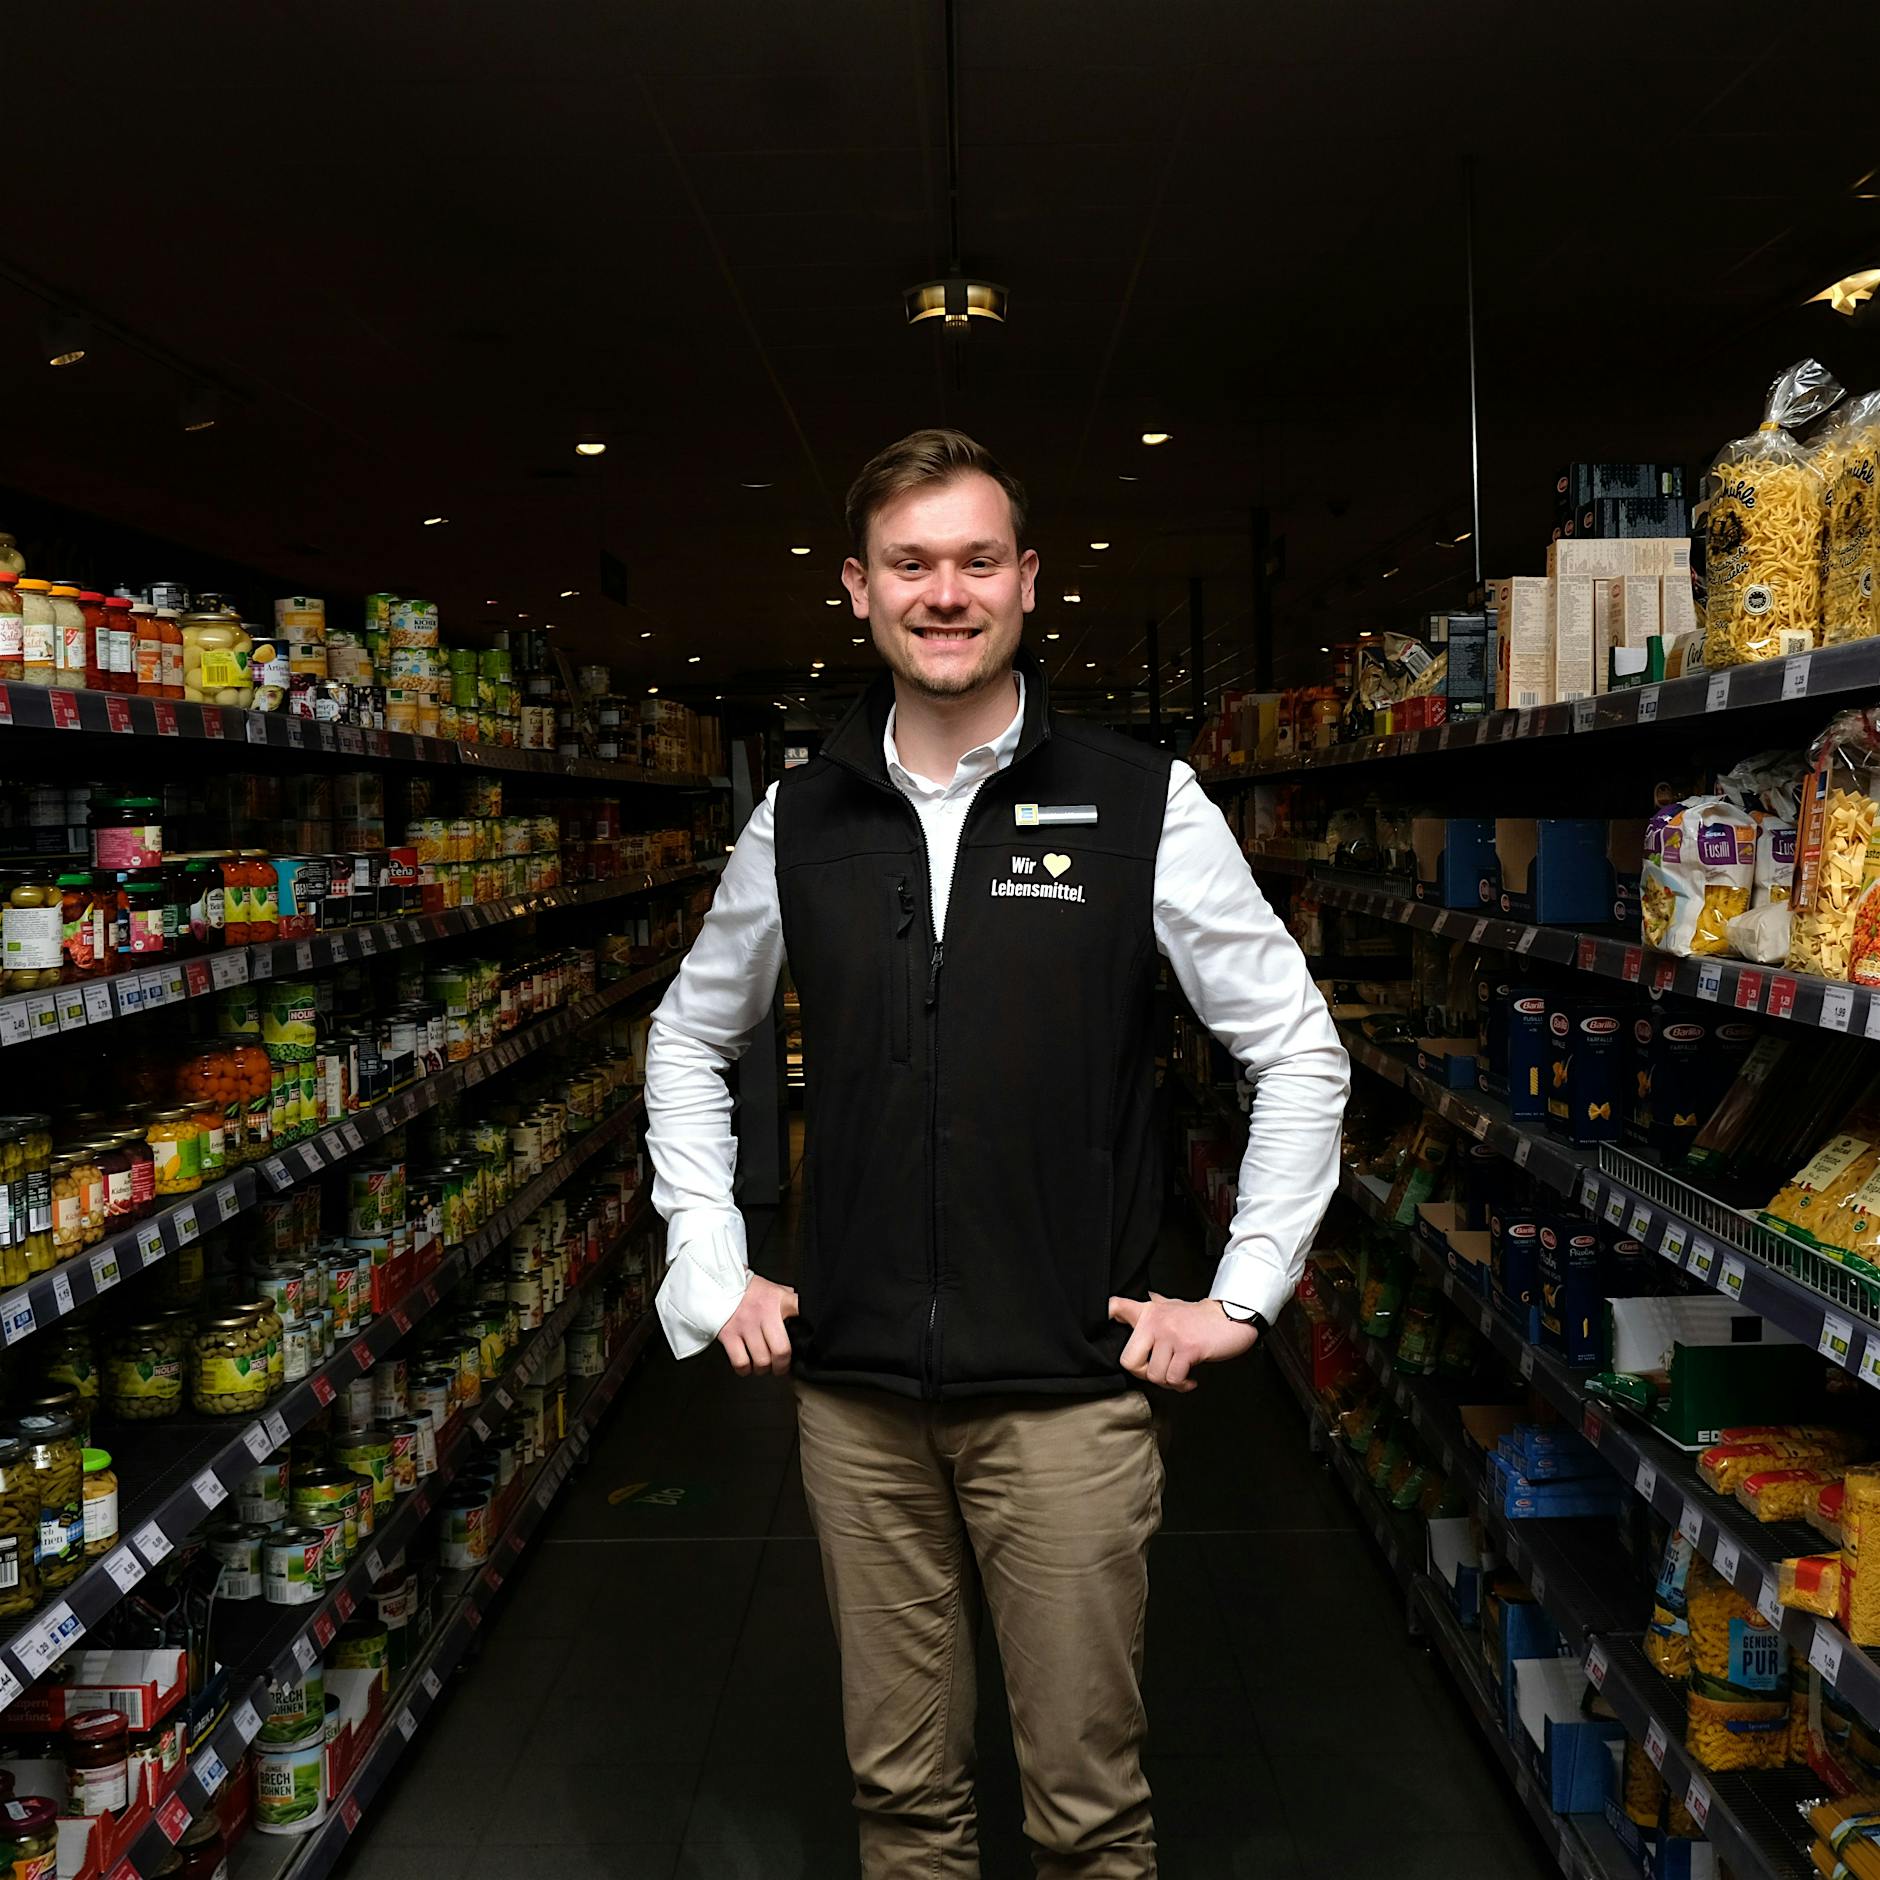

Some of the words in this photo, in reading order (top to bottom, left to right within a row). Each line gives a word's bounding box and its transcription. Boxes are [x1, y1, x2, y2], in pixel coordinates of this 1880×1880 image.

[1704, 842, 1731, 859] Fusilli
[1011, 856, 1038, 875] Wir
[990, 878, 1087, 904] Lebensmittel.
[1588, 1020, 1618, 1031] Barilla
[1671, 1026, 1702, 1038] Barilla
[1743, 1635, 1778, 1648] GENUSS
[1742, 1650, 1778, 1676] PUR
[260, 1772, 291, 1786] BRECH
[260, 1784, 293, 1796] BOHNEN
